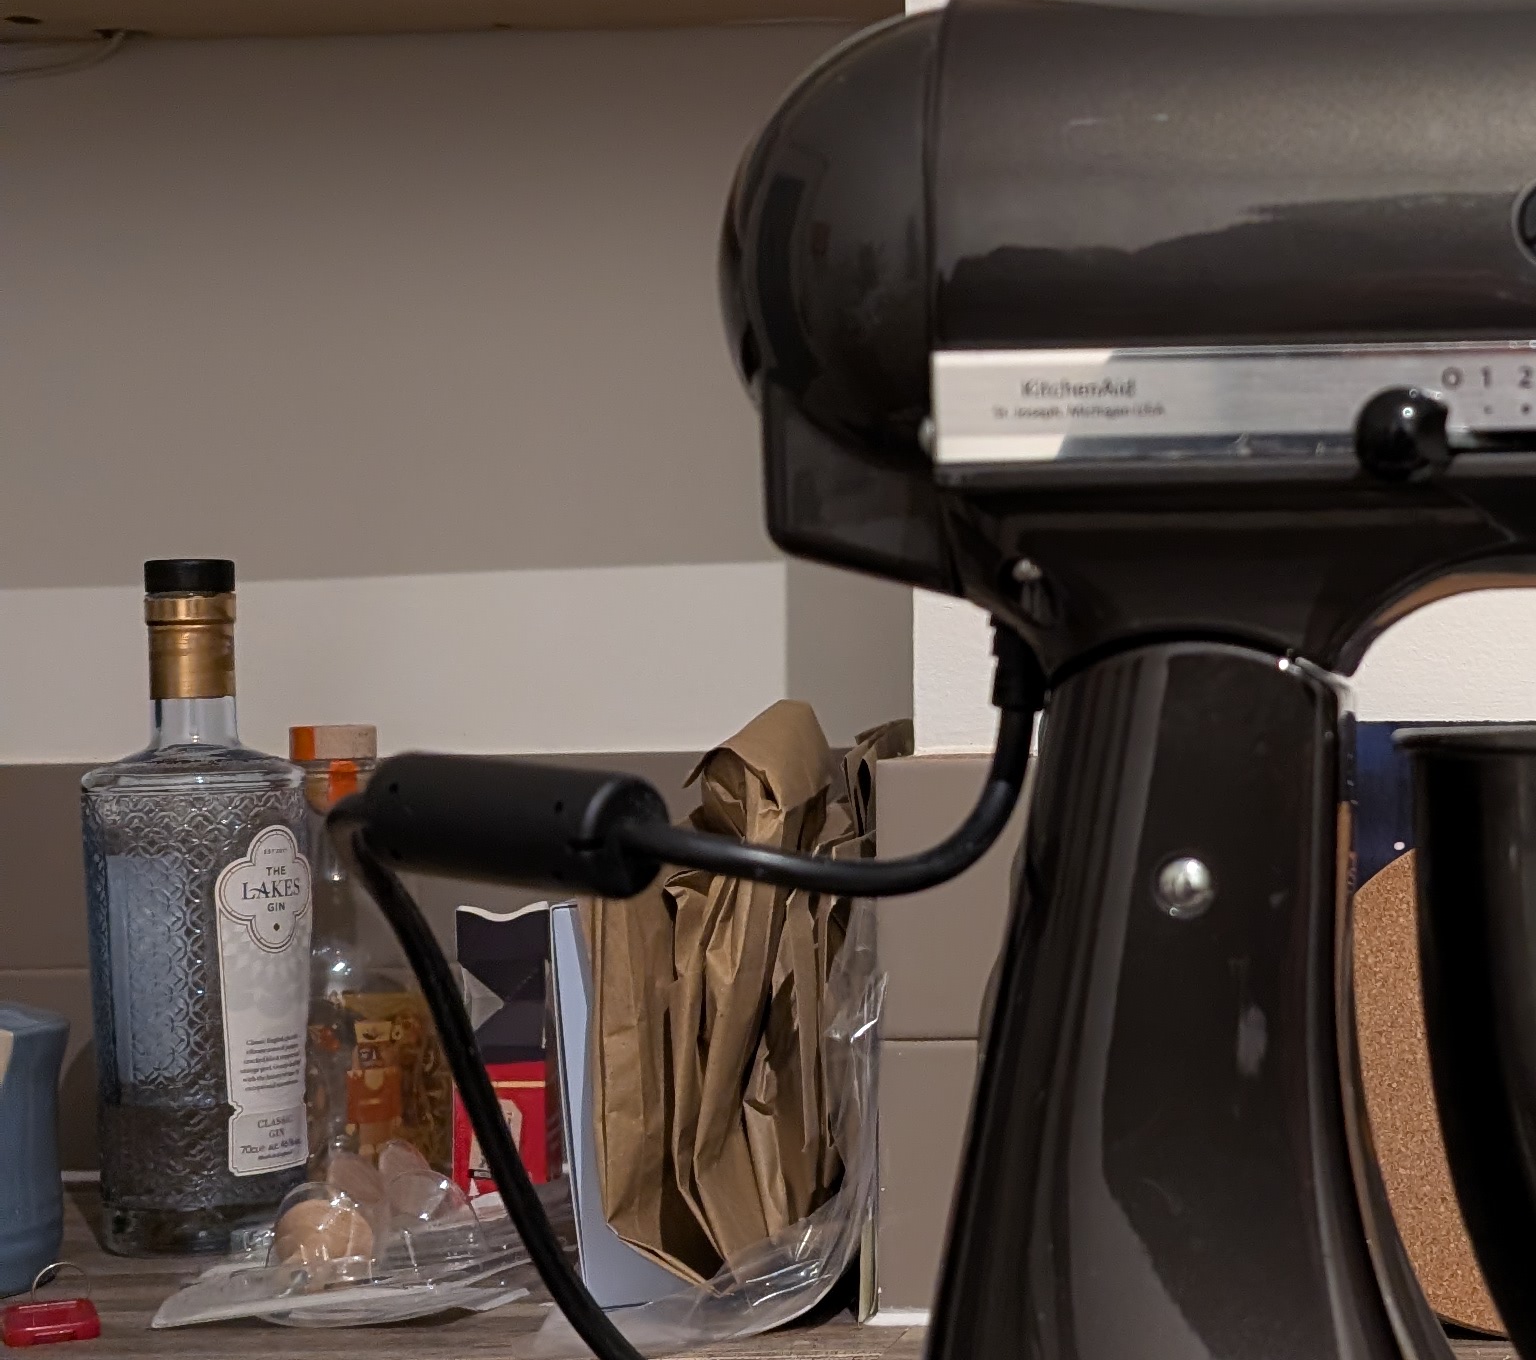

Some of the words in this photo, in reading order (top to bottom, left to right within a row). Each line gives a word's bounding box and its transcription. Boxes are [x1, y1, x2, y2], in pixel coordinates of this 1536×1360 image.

[1482, 365, 1493, 388] 1
[1519, 365, 1533, 389] 2
[266, 865, 286, 876] THE
[241, 878, 300, 900] LAKES
[267, 902, 286, 912] GIN
[268, 1128, 285, 1138] GIN
